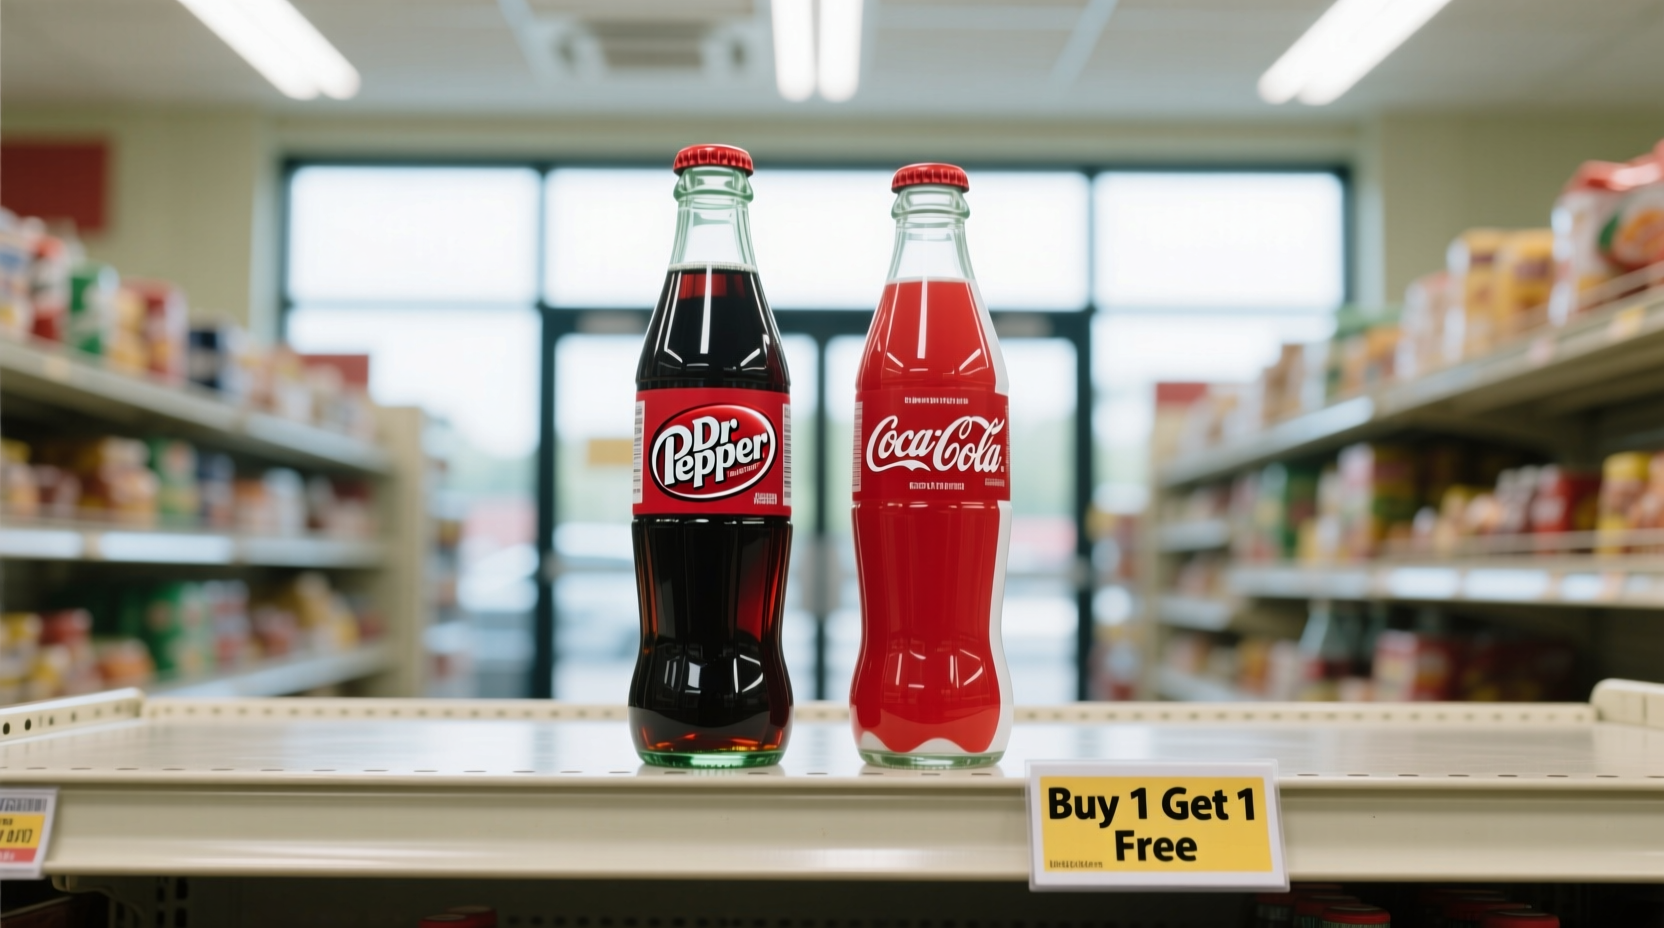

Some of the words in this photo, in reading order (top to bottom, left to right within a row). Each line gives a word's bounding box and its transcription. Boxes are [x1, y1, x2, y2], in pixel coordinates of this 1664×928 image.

[692, 415, 738, 452] Dr
[866, 415, 1005, 473] Coca-Cola
[653, 424, 768, 488] Pepper
[1048, 787, 1119, 829] Buy
[1130, 787, 1148, 820] 1
[1161, 786, 1229, 821] Get
[1237, 787, 1255, 821] 1
[1115, 830, 1198, 862] Free
